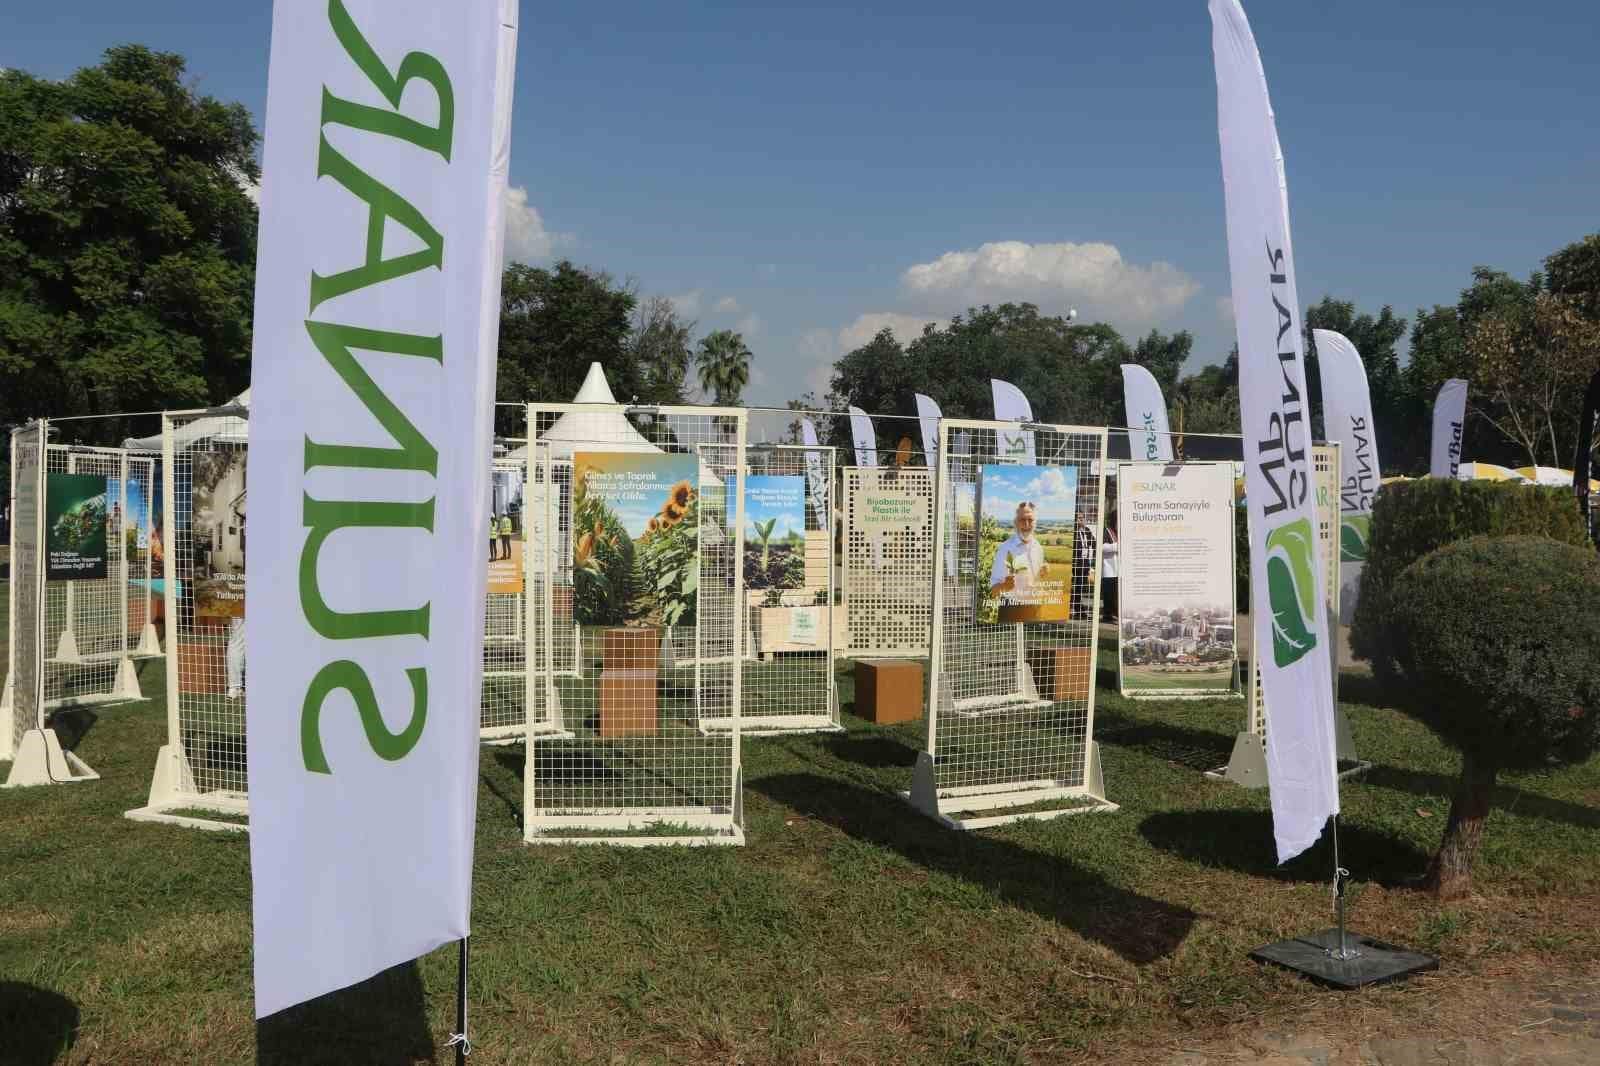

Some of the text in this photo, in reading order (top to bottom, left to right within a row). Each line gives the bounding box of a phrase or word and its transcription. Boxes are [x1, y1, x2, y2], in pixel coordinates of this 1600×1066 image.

[626, 471, 656, 482] Toprak
[873, 506, 898, 514] Plastik
[1133, 500, 1210, 512] Tarımı Sanayiyle
[1132, 512, 1184, 522] Buluşturan
